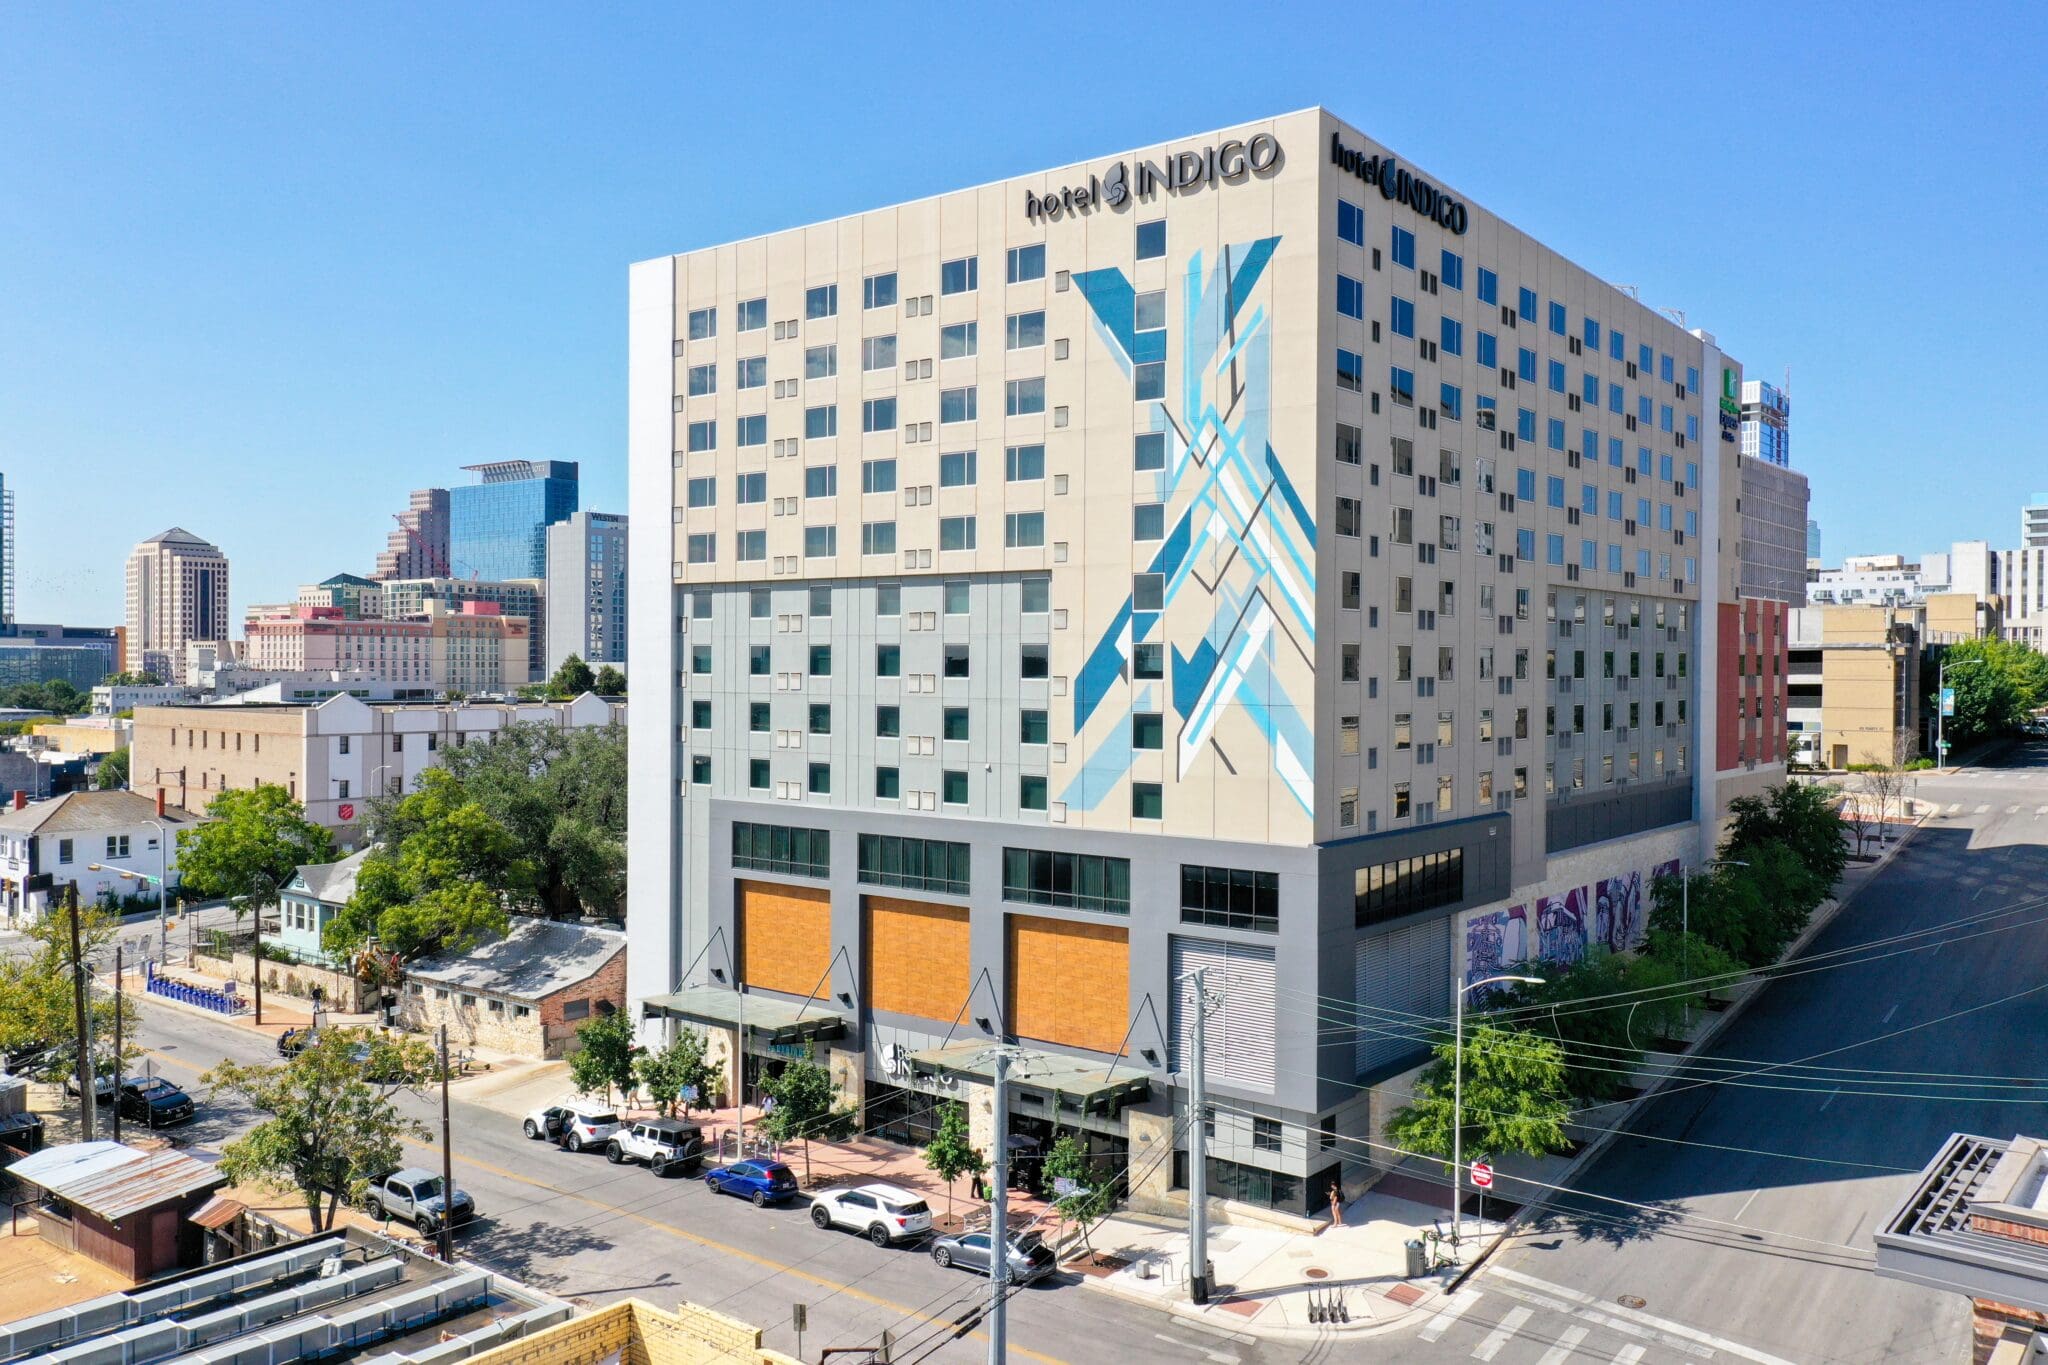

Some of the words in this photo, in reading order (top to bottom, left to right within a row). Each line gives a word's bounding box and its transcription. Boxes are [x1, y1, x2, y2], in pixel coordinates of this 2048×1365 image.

[1024, 174, 1096, 218] hotel
[1134, 132, 1279, 196] INDIGO
[1331, 131, 1379, 186] hotel
[1396, 168, 1469, 235] INDIGO
[591, 512, 619, 522] WESTIN
